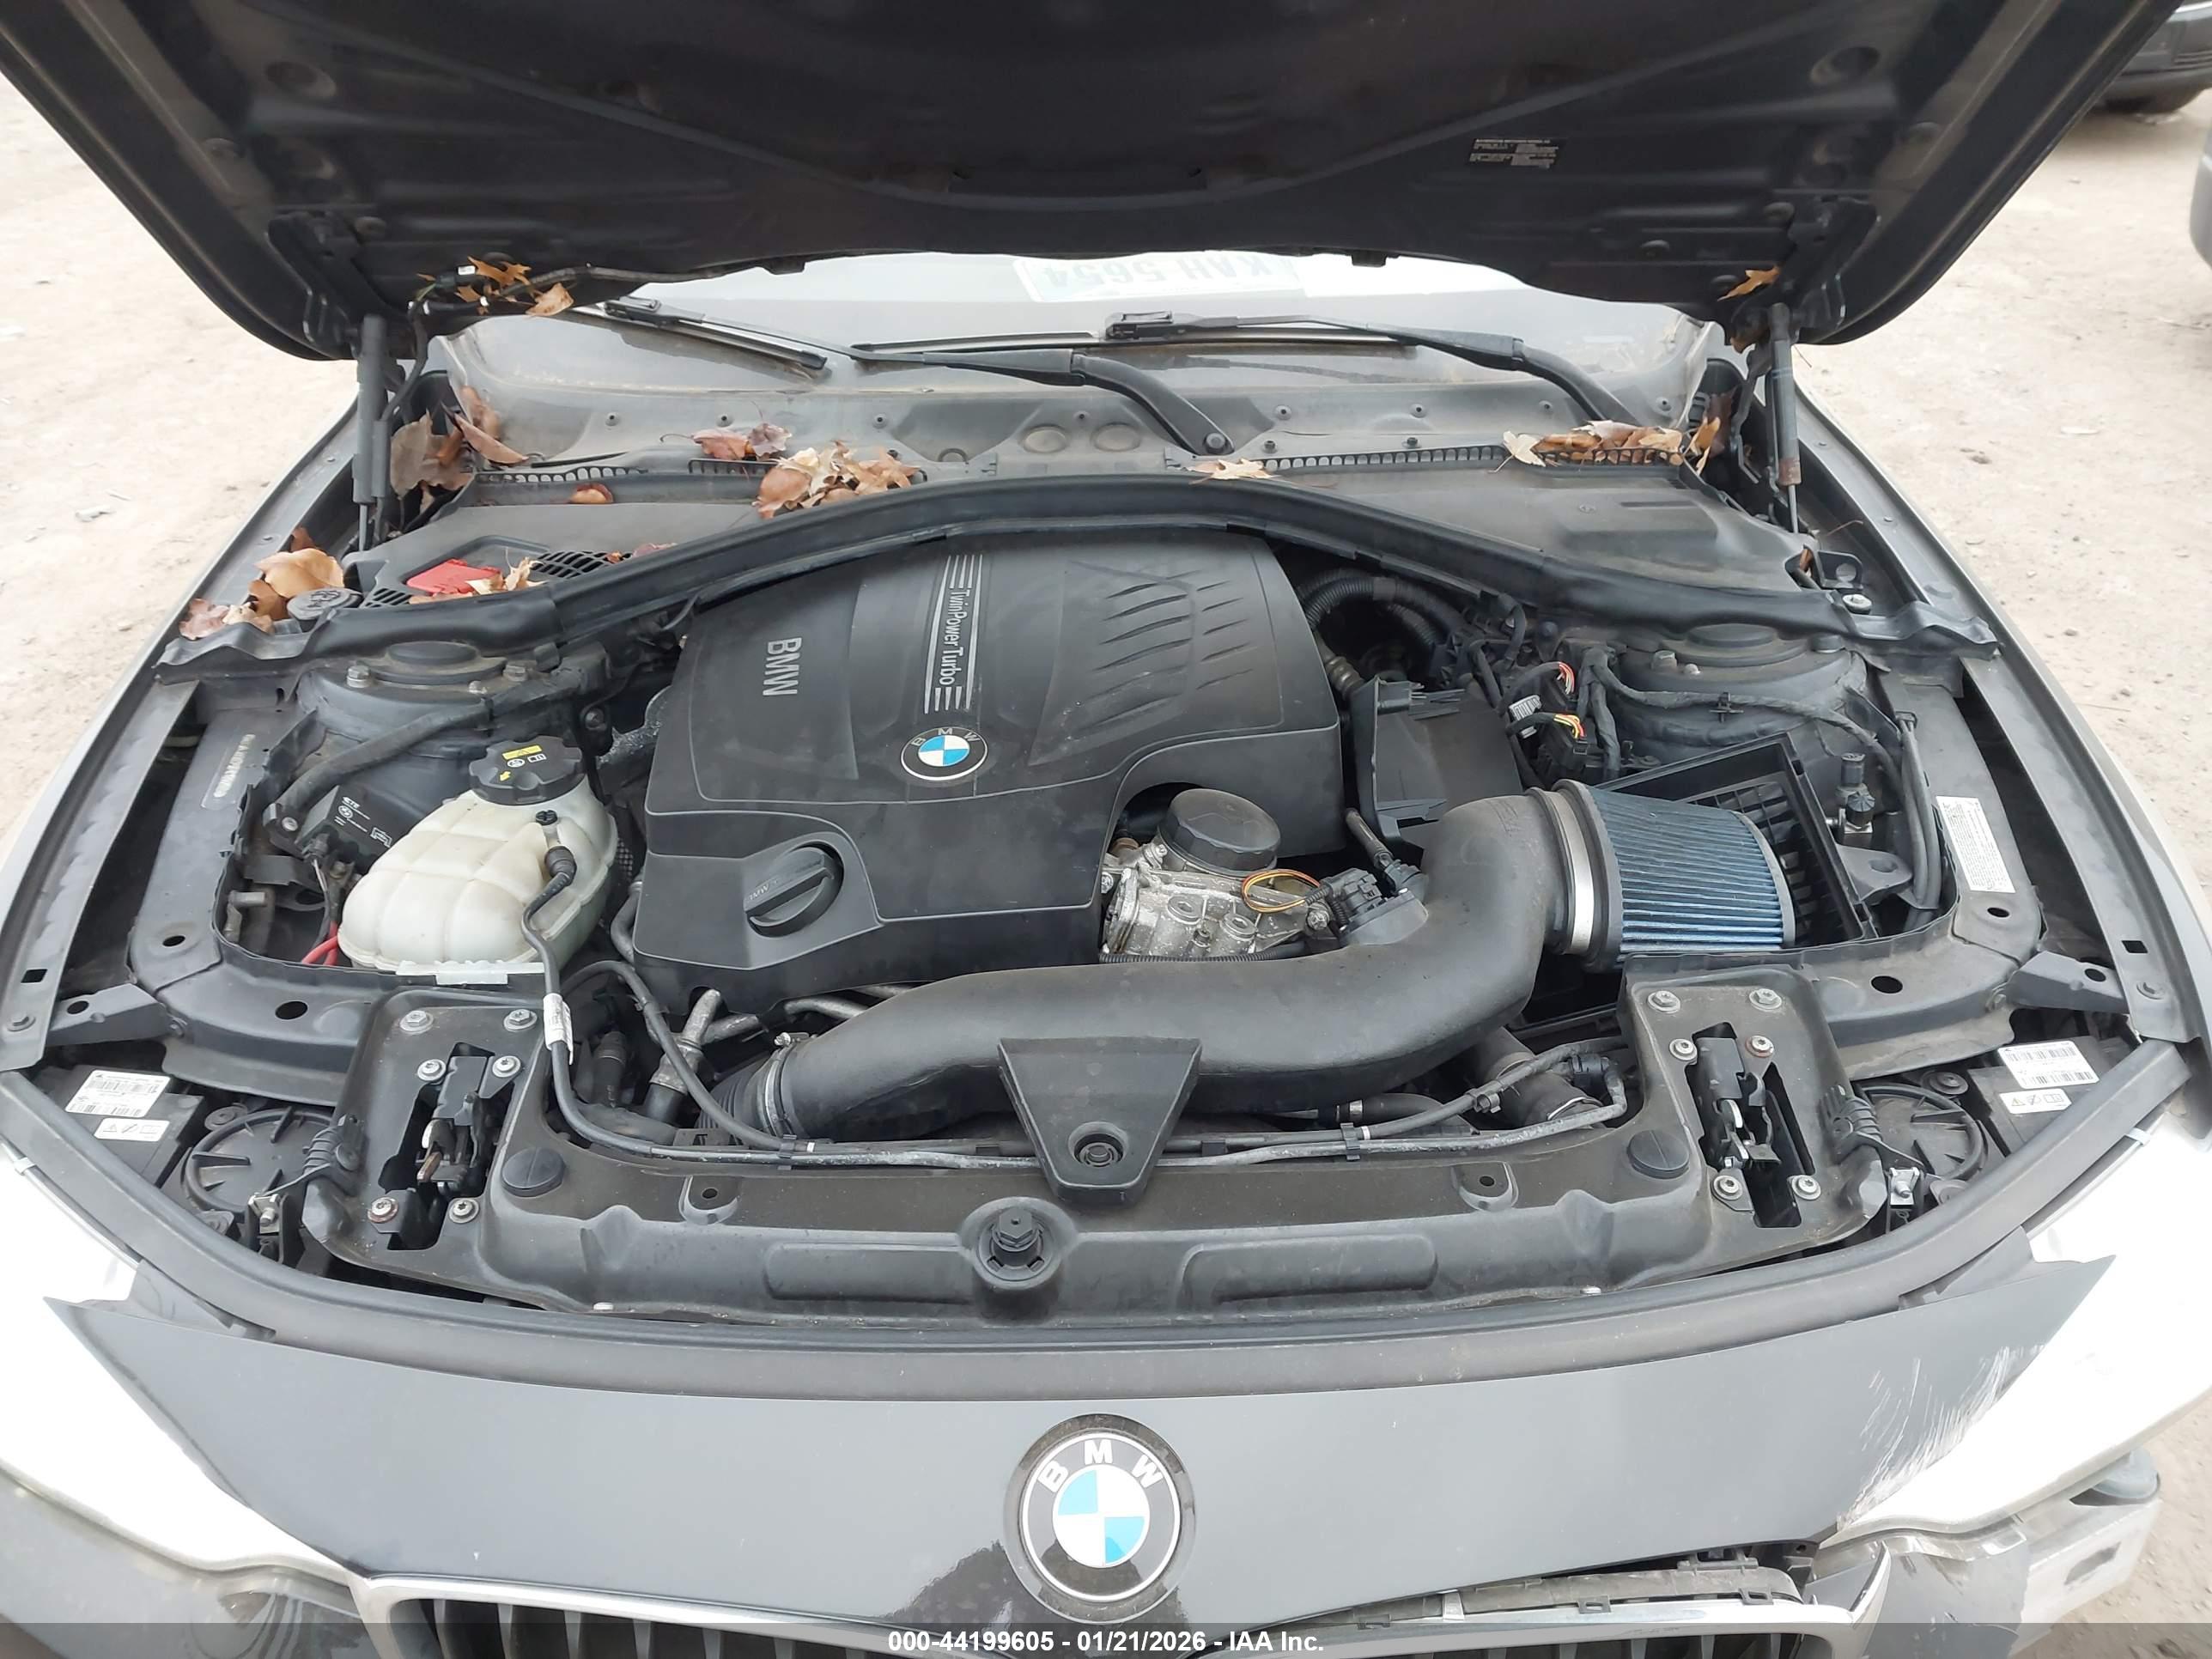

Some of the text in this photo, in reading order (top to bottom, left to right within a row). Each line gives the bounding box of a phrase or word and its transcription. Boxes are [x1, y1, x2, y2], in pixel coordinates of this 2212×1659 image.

[1176, 254, 1273, 280] KAH
[939, 589, 970, 685] TwinPower Turbo
[763, 637, 802, 696] BMW
[911, 727, 981, 746] BMW
[1037, 1438, 1164, 1492] BMW
